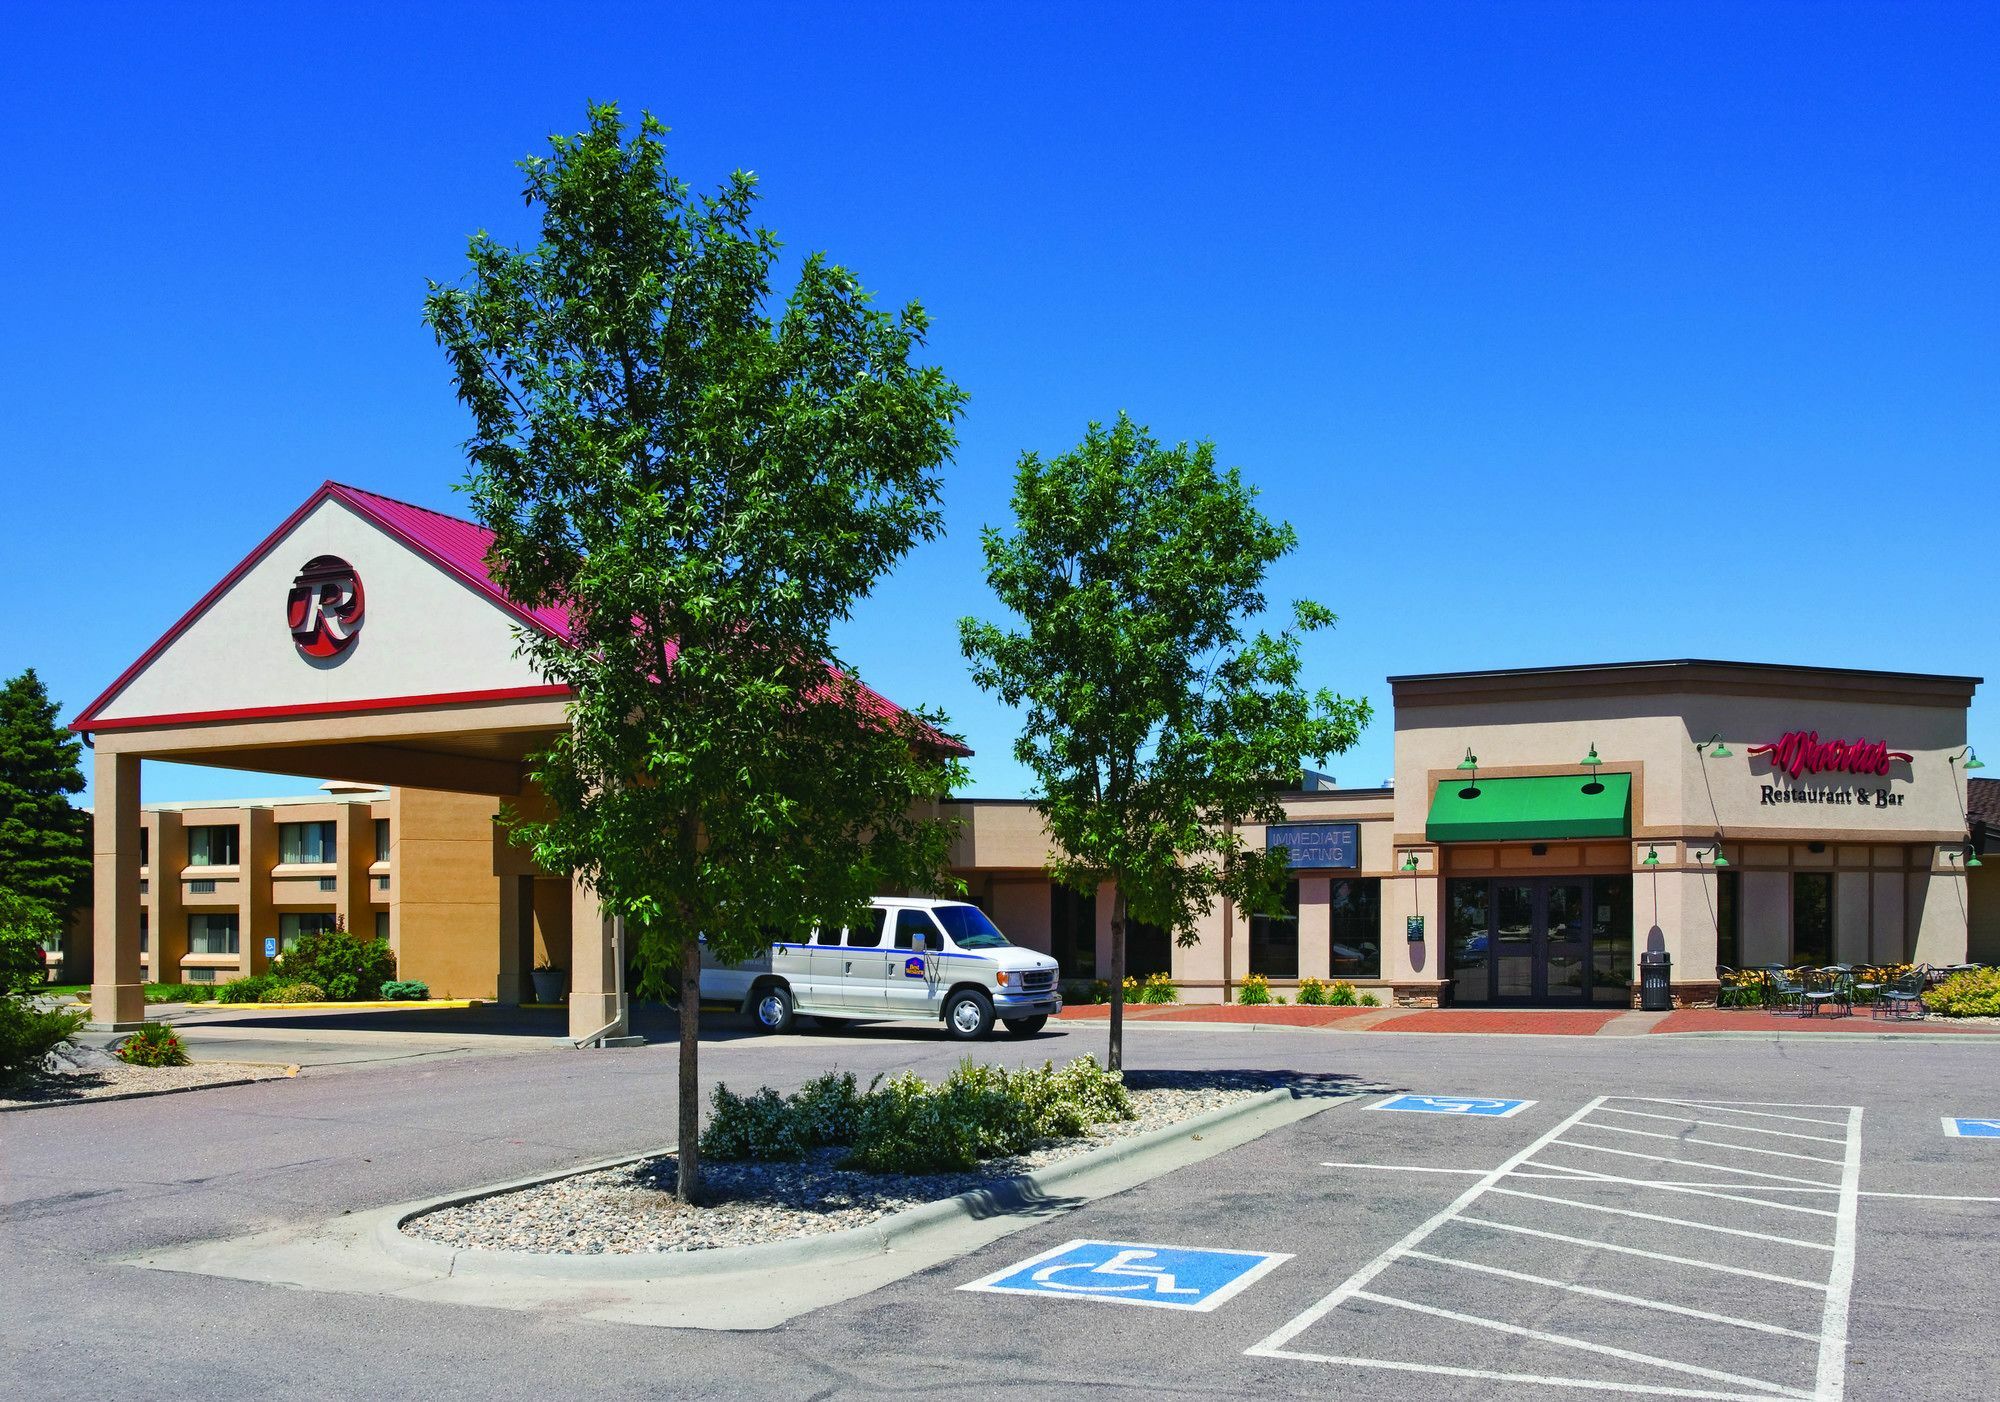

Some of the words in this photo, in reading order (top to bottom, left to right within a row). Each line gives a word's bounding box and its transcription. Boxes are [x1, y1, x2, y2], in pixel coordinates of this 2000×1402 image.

[1760, 785, 1852, 806] Restaurant
[1856, 787, 1870, 805] &
[1875, 788, 1904, 808] Bar
[1273, 831, 1352, 845] IMMEDIATE
